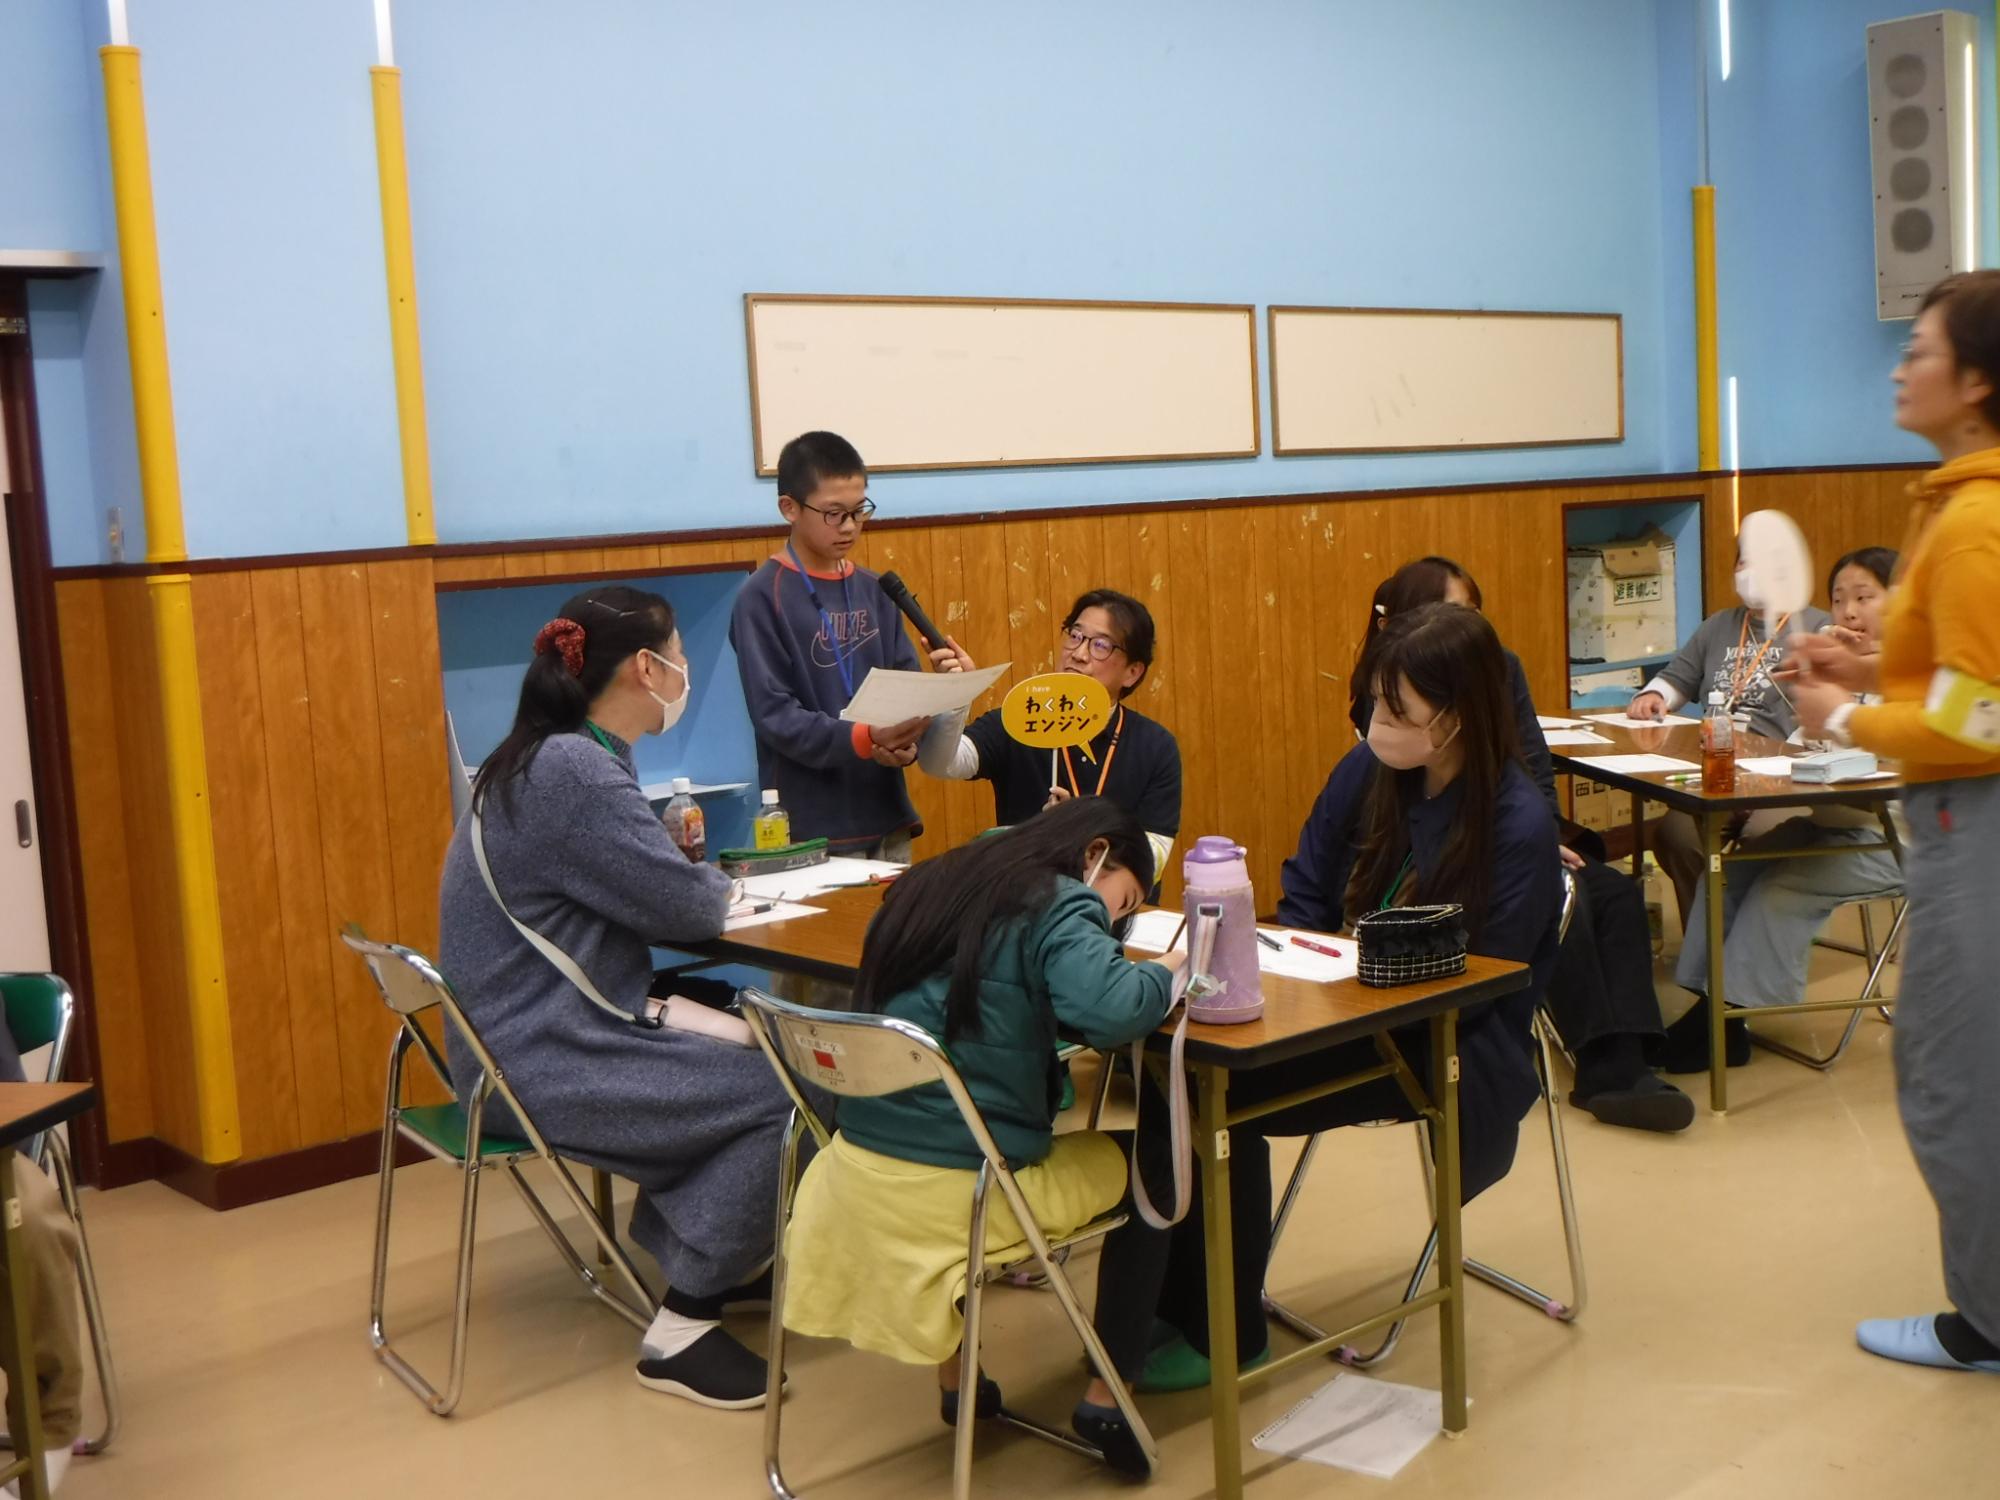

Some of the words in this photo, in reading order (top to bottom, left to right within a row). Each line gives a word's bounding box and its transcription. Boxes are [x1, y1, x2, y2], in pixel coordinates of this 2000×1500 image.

[1025, 694, 1088, 714] わくわく
[1025, 715, 1090, 733] エンジン
